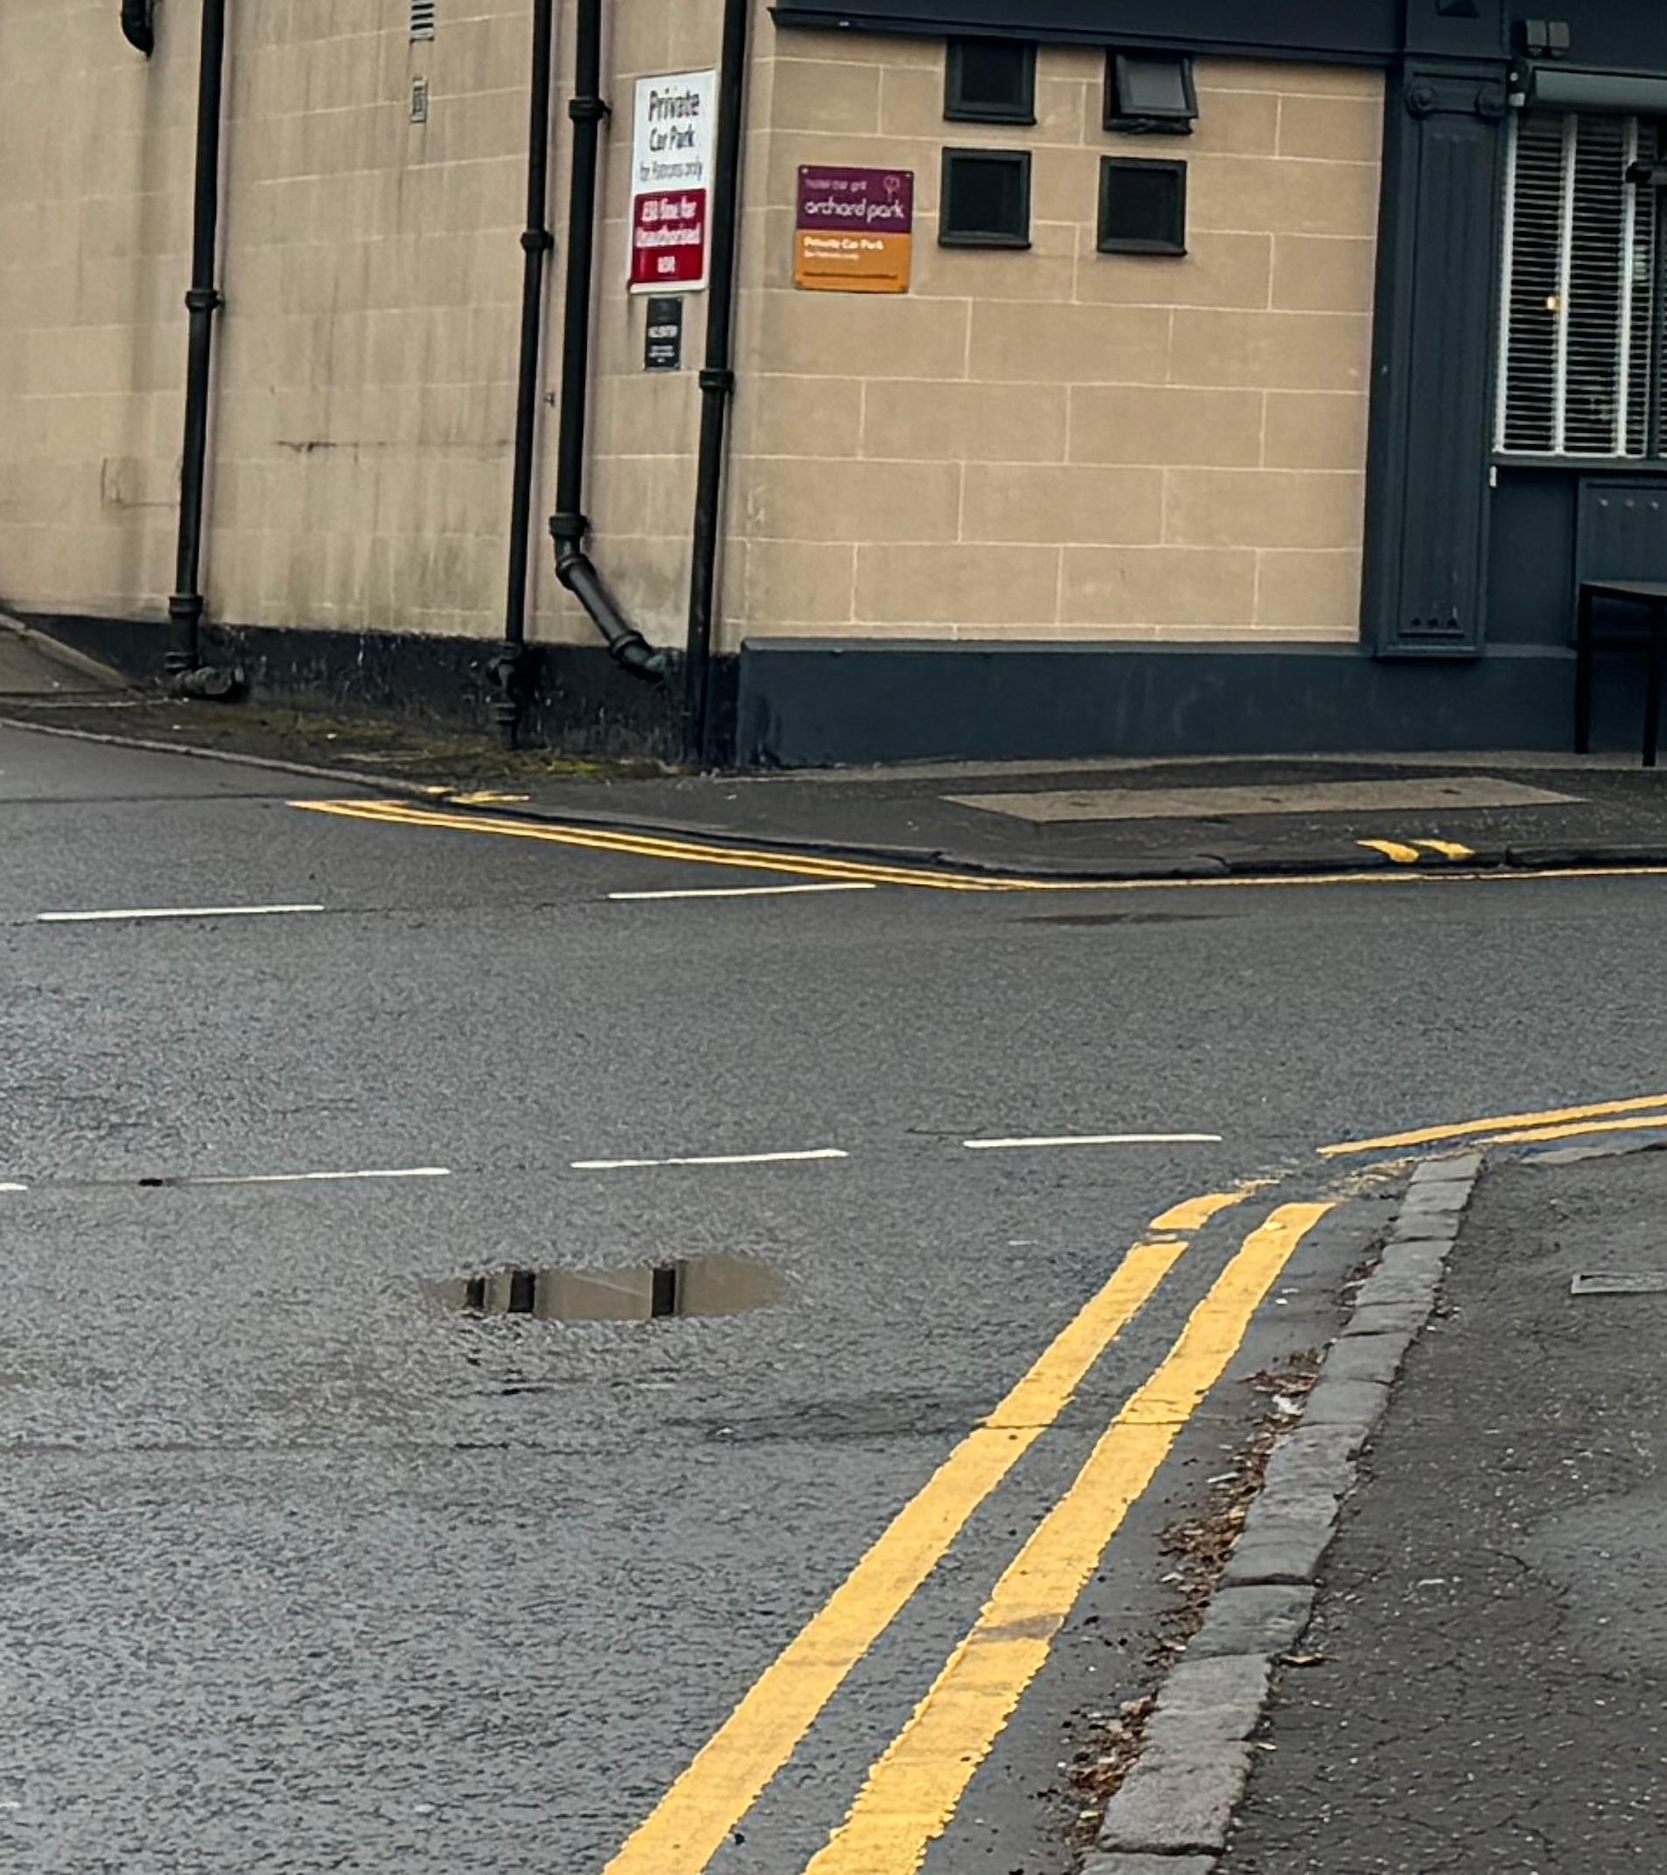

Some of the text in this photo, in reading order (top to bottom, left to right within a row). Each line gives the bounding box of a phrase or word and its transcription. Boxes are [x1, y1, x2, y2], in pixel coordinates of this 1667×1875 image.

[648, 87, 700, 122] Private
[650, 124, 695, 152] Car Park
[805, 196, 904, 223] orchard park
